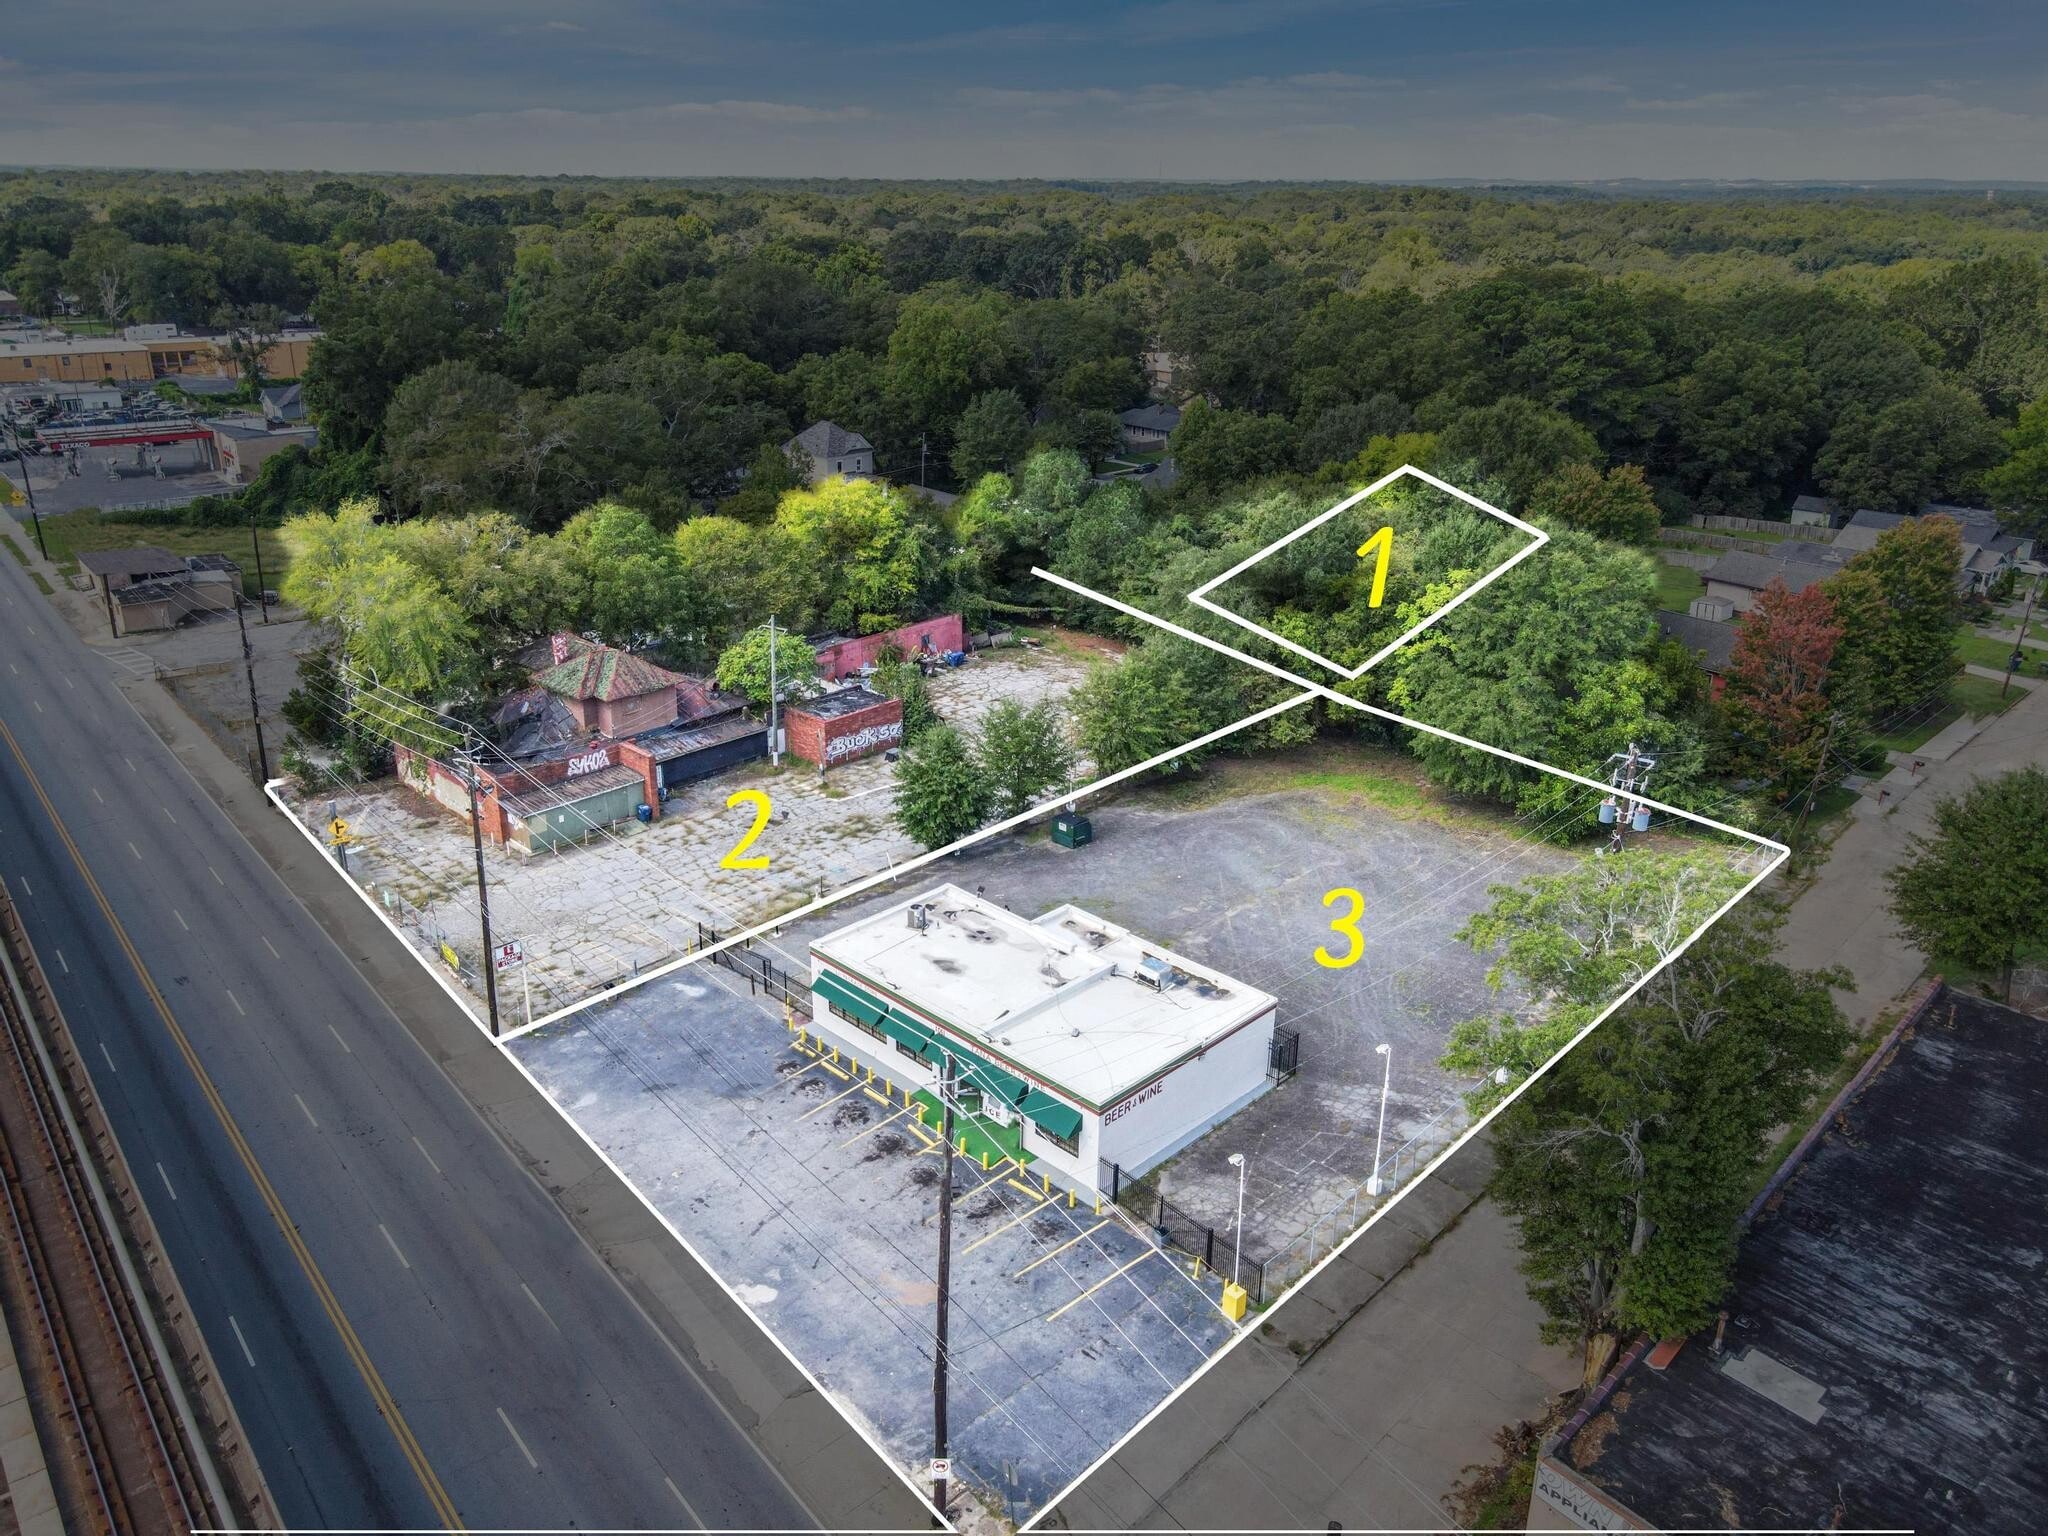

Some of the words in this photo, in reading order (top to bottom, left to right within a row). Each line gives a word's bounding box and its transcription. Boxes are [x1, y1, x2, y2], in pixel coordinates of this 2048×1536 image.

[1023, 1074, 1047, 1093] WINE
[985, 1105, 1001, 1119] ICE
[1105, 1101, 1131, 1126] BEER
[1139, 1081, 1163, 1104] WINE
